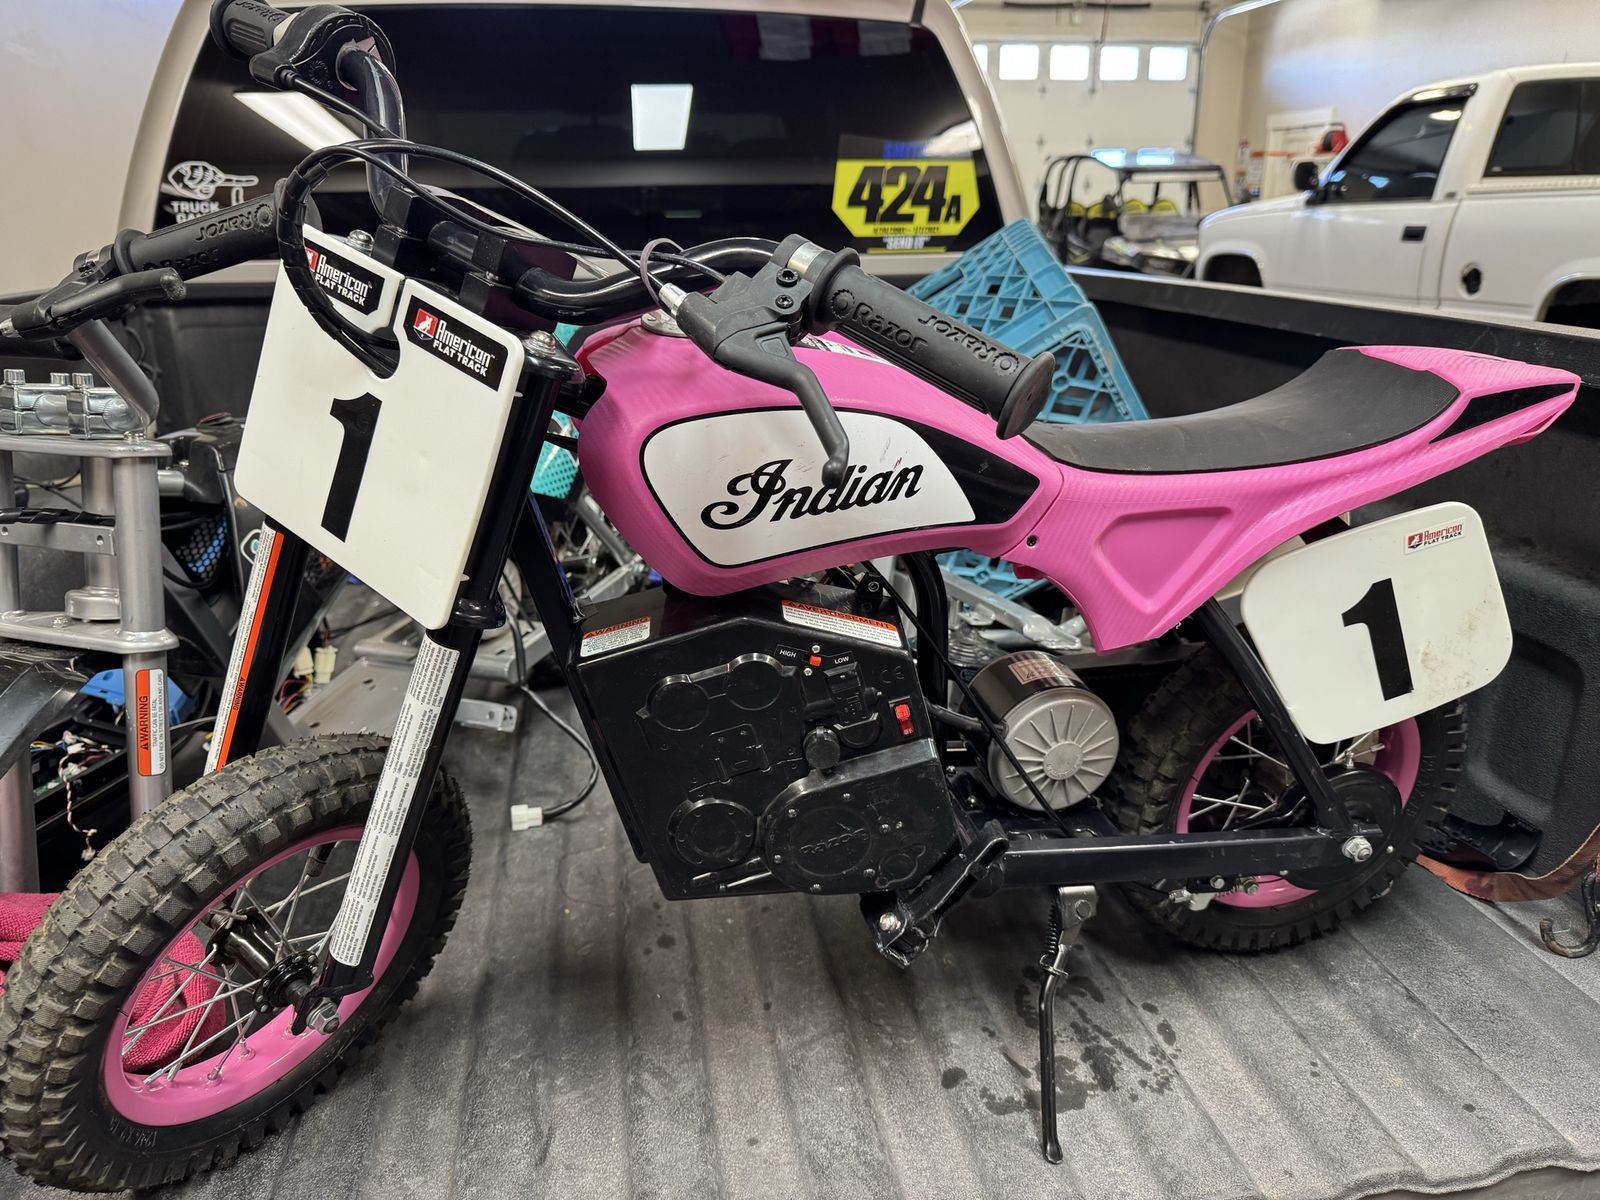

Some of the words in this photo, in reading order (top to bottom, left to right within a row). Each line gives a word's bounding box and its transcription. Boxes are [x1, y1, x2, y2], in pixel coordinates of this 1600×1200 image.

[171, 200, 221, 213] TRUCK
[315, 273, 336, 290] FLAT
[337, 285, 366, 307] TRACK
[317, 254, 369, 297] American
[435, 319, 491, 368] American
[852, 302, 928, 353] Razor
[918, 315, 996, 359] Razor
[433, 340, 456, 358] FLAT
[457, 353, 488, 377] TRACK
[321, 392, 383, 543] 1
[700, 459, 924, 530] Indian
[1424, 524, 1463, 541] American
[1424, 537, 1440, 546] FLAT
[1442, 531, 1462, 540] TRACK
[779, 649, 797, 659] HIGH
[1341, 577, 1414, 701] 1
[834, 655, 849, 665] LOW
[233, 681, 246, 711] WARNING
[139, 695, 149, 741] WARNING
